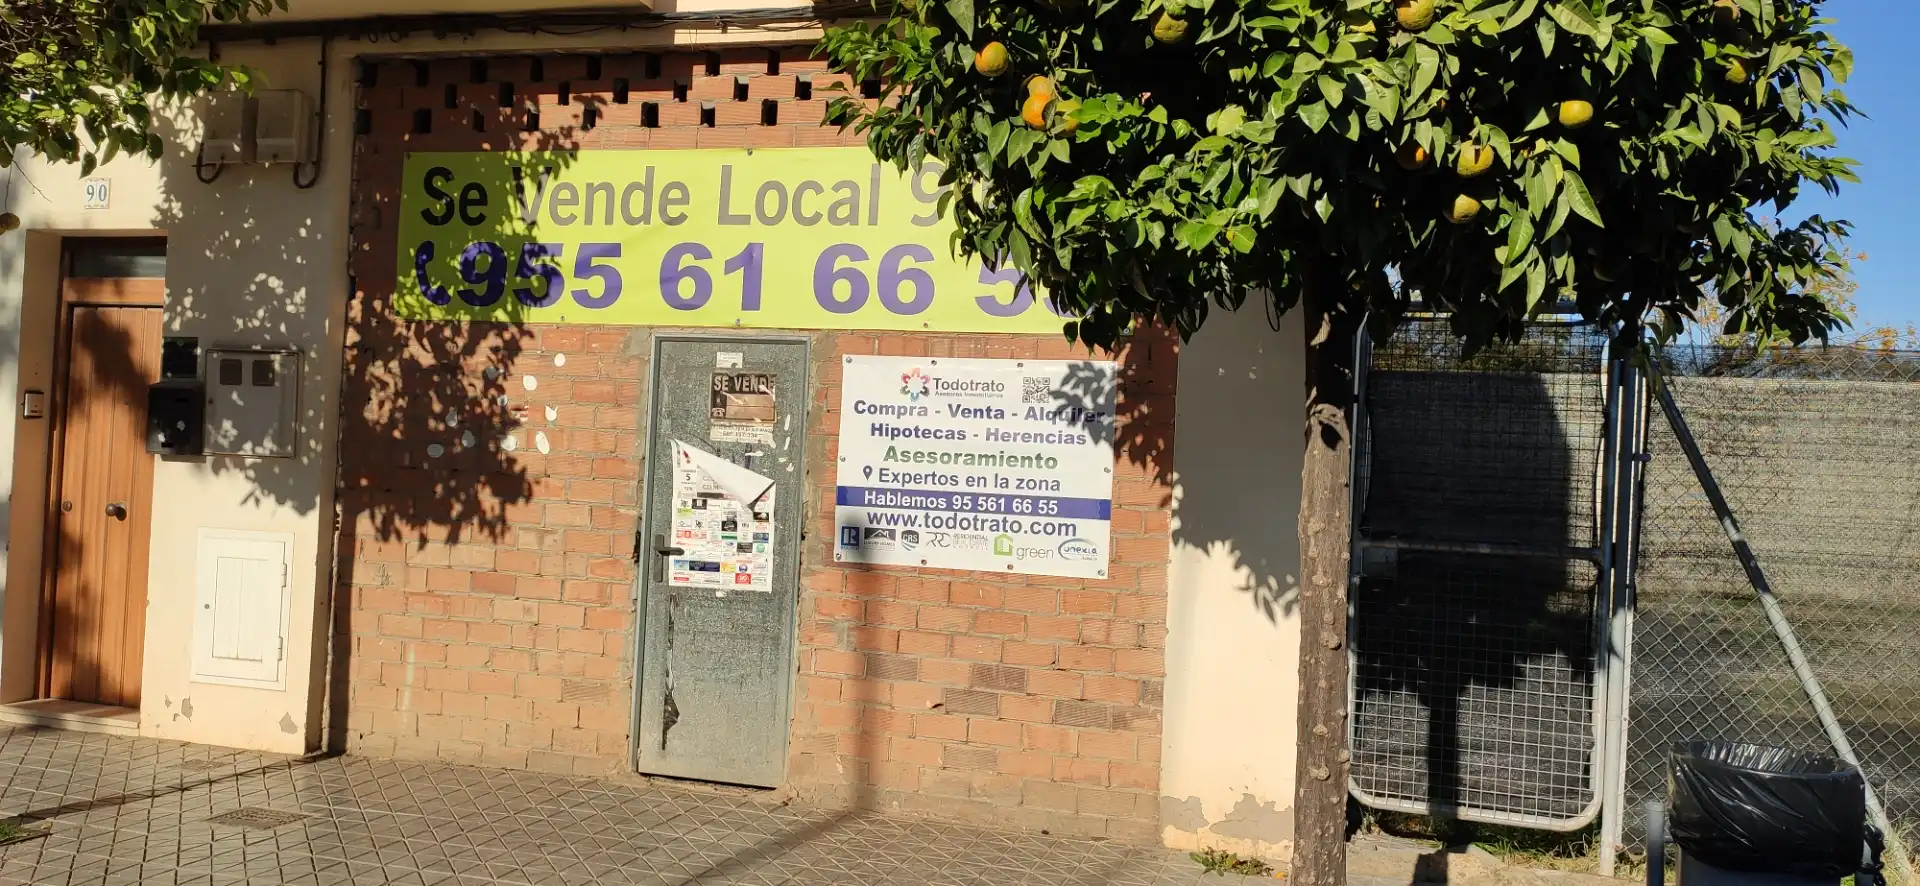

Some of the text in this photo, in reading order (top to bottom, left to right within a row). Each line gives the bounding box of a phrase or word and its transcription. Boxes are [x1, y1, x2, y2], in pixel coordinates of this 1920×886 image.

[87, 185, 107, 202] 90
[420, 166, 489, 227] Se
[513, 165, 691, 227] Vende
[718, 163, 880, 227] Local
[456, 241, 1082, 319] 955 61 66 5
[714, 375, 729, 392] SE
[933, 377, 1005, 392] Todotrato
[854, 400, 928, 418] Compra
[948, 403, 1005, 420] Venta
[1024, 406, 1105, 425] Alquiler
[870, 423, 966, 441] Hipotecas
[986, 428, 1087, 445] Herencias
[883, 445, 1058, 469] Asesoramiento
[685, 473, 691, 481] 5
[878, 468, 1061, 492] Expertos en la zona
[864, 491, 1058, 514] Hablemos 95 561 66 55
[867, 511, 1077, 537] www.todotrato.com
[903, 533, 918, 543] CRS
[1016, 546, 1054, 560] green
